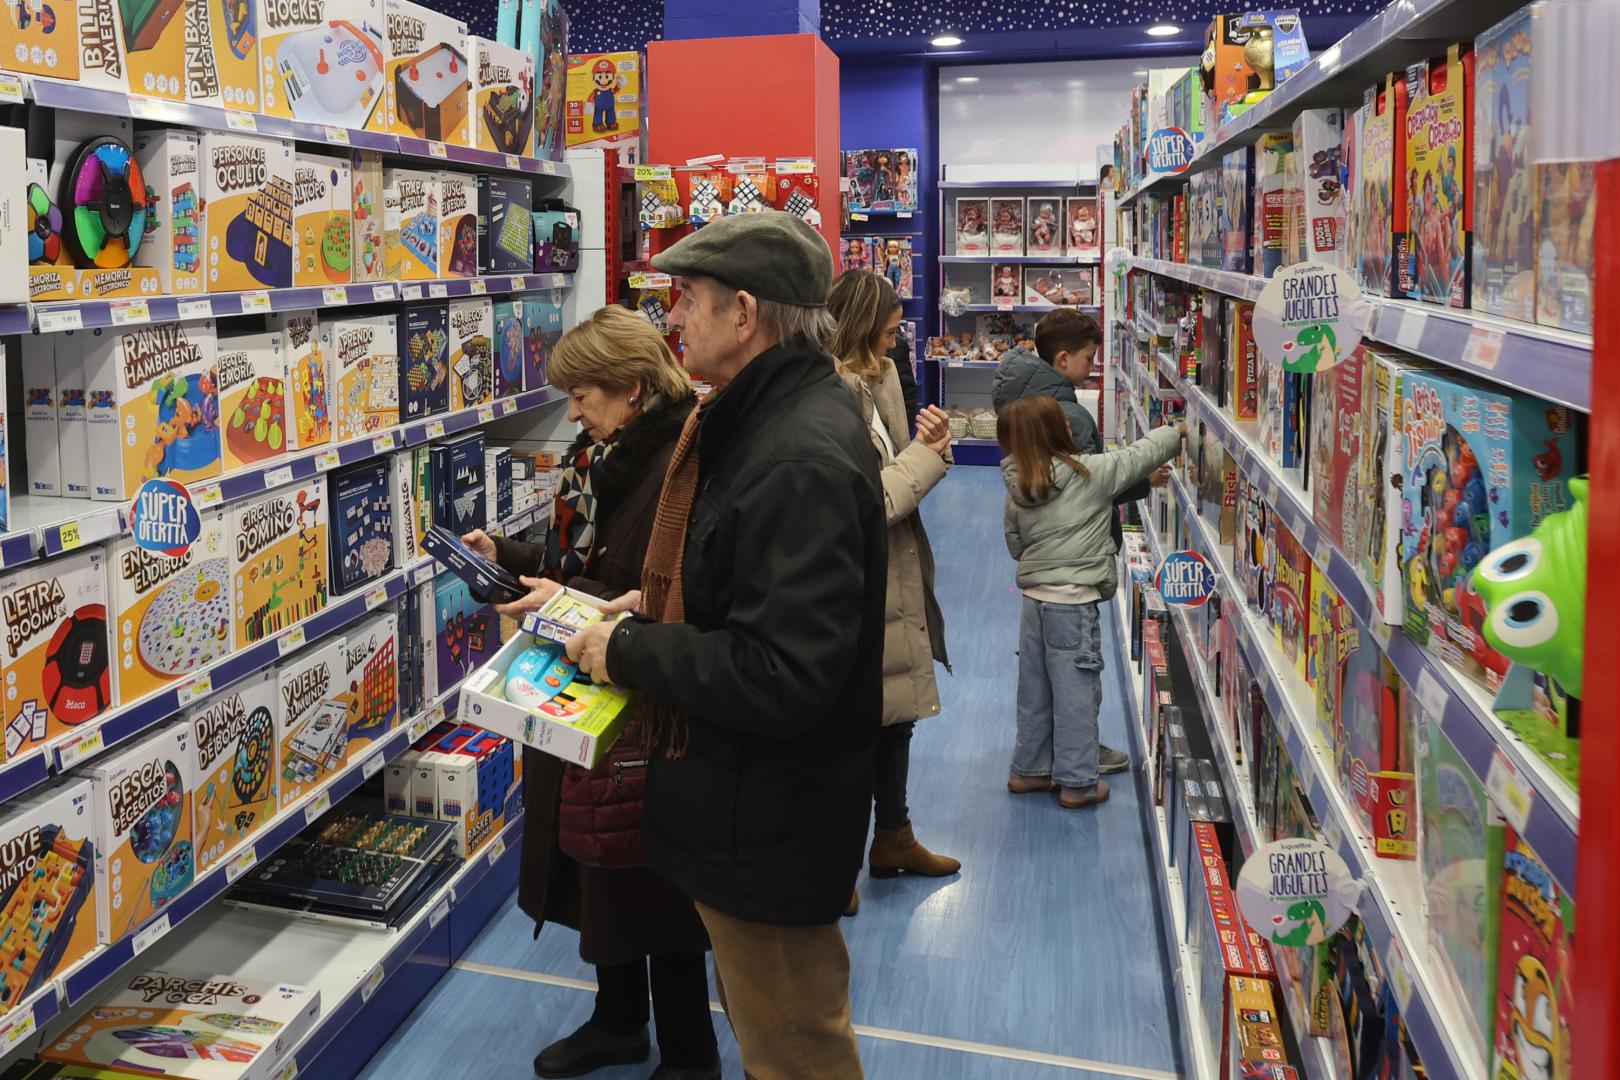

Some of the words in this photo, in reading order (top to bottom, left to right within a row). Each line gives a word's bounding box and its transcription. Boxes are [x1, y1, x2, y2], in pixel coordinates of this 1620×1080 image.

[386, 14, 426, 42] HOCKEY
[391, 39, 402, 56] DE
[1152, 131, 1185, 154] SÚPER
[212, 146, 266, 168] PERSONAJE
[1153, 149, 1187, 169] OFERTTA
[216, 161, 267, 192] OCULTO
[295, 168, 317, 185] TRAPA
[637, 168, 652, 176] 20%
[304, 181, 326, 203] TOPO
[441, 180, 465, 200] BUSCA
[29, 272, 62, 287] EMORIZA
[94, 270, 132, 287] MEMORIZA
[630, 276, 645, 285] 20%
[1283, 273, 1338, 301] GRANDES
[1281, 295, 1339, 322] JUGUETES
[121, 322, 188, 365] RANITA
[337, 327, 375, 358] APRENDO
[123, 342, 203, 389] HAMBRIENTA
[219, 363, 255, 391] EMORIA
[1225, 471, 1237, 510] Risk
[141, 487, 187, 526] SÚPER
[241, 496, 286, 529] CIRCUITO
[62, 528, 80, 544] 25%
[139, 518, 189, 545] OFERTTA
[236, 500, 296, 563] DOMINÓ
[134, 568, 149, 595] EL
[148, 549, 194, 585] DIBUJO
[1164, 557, 1204, 584] SÚPER
[2, 577, 66, 626] LETRA
[1164, 580, 1206, 599] OFERTTA
[7, 600, 58, 658] ¡BOOM!
[346, 641, 367, 676] ÍNEA
[367, 634, 378, 654] 4
[282, 661, 331, 707] VUELTA
[195, 692, 246, 743] DIANA
[285, 705, 297, 727] AL
[295, 680, 330, 716] MUNDO
[198, 744, 215, 771] DE
[109, 758, 167, 818] PESCA
[113, 778, 168, 837] PECECITOS
[0, 825, 41, 868] UYE
[0, 854, 37, 892] INTO
[1269, 851, 1326, 875] GRANDES
[1269, 873, 1329, 896] JUGUETES
[128, 975, 249, 998] PARCHÍS
[142, 989, 161, 1004] Y
[161, 990, 218, 1006] OCA
